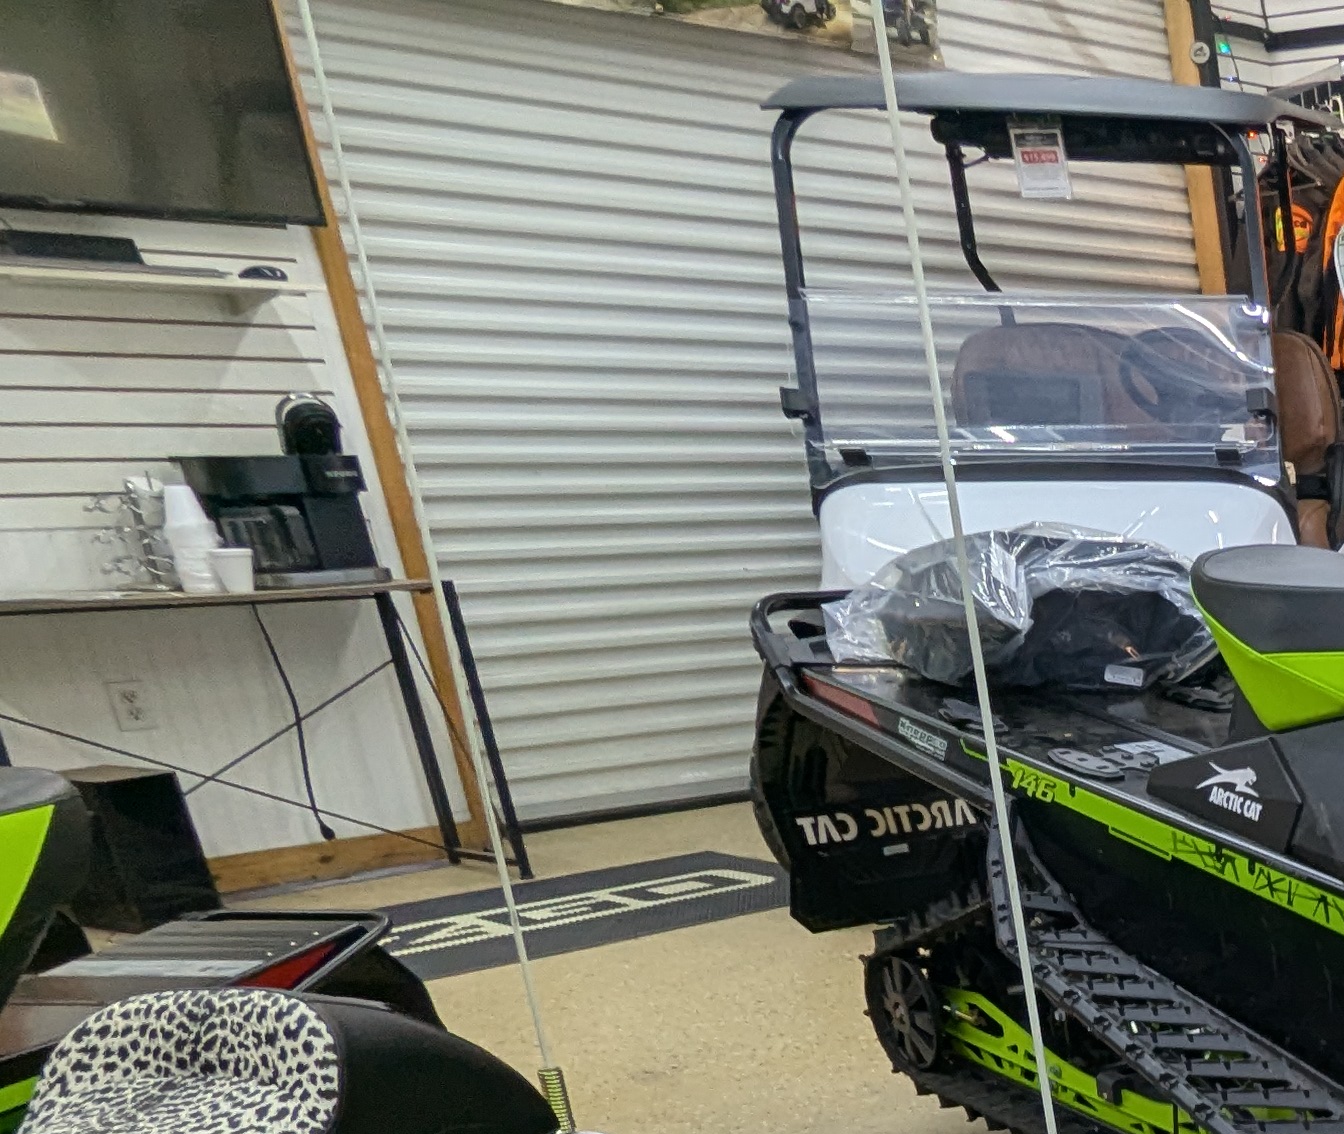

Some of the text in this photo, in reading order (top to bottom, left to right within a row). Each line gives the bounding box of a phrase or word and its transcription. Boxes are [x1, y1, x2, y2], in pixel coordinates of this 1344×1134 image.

[1012, 768, 1058, 803] 146
[1208, 785, 1264, 823] ARCTIC CAT
